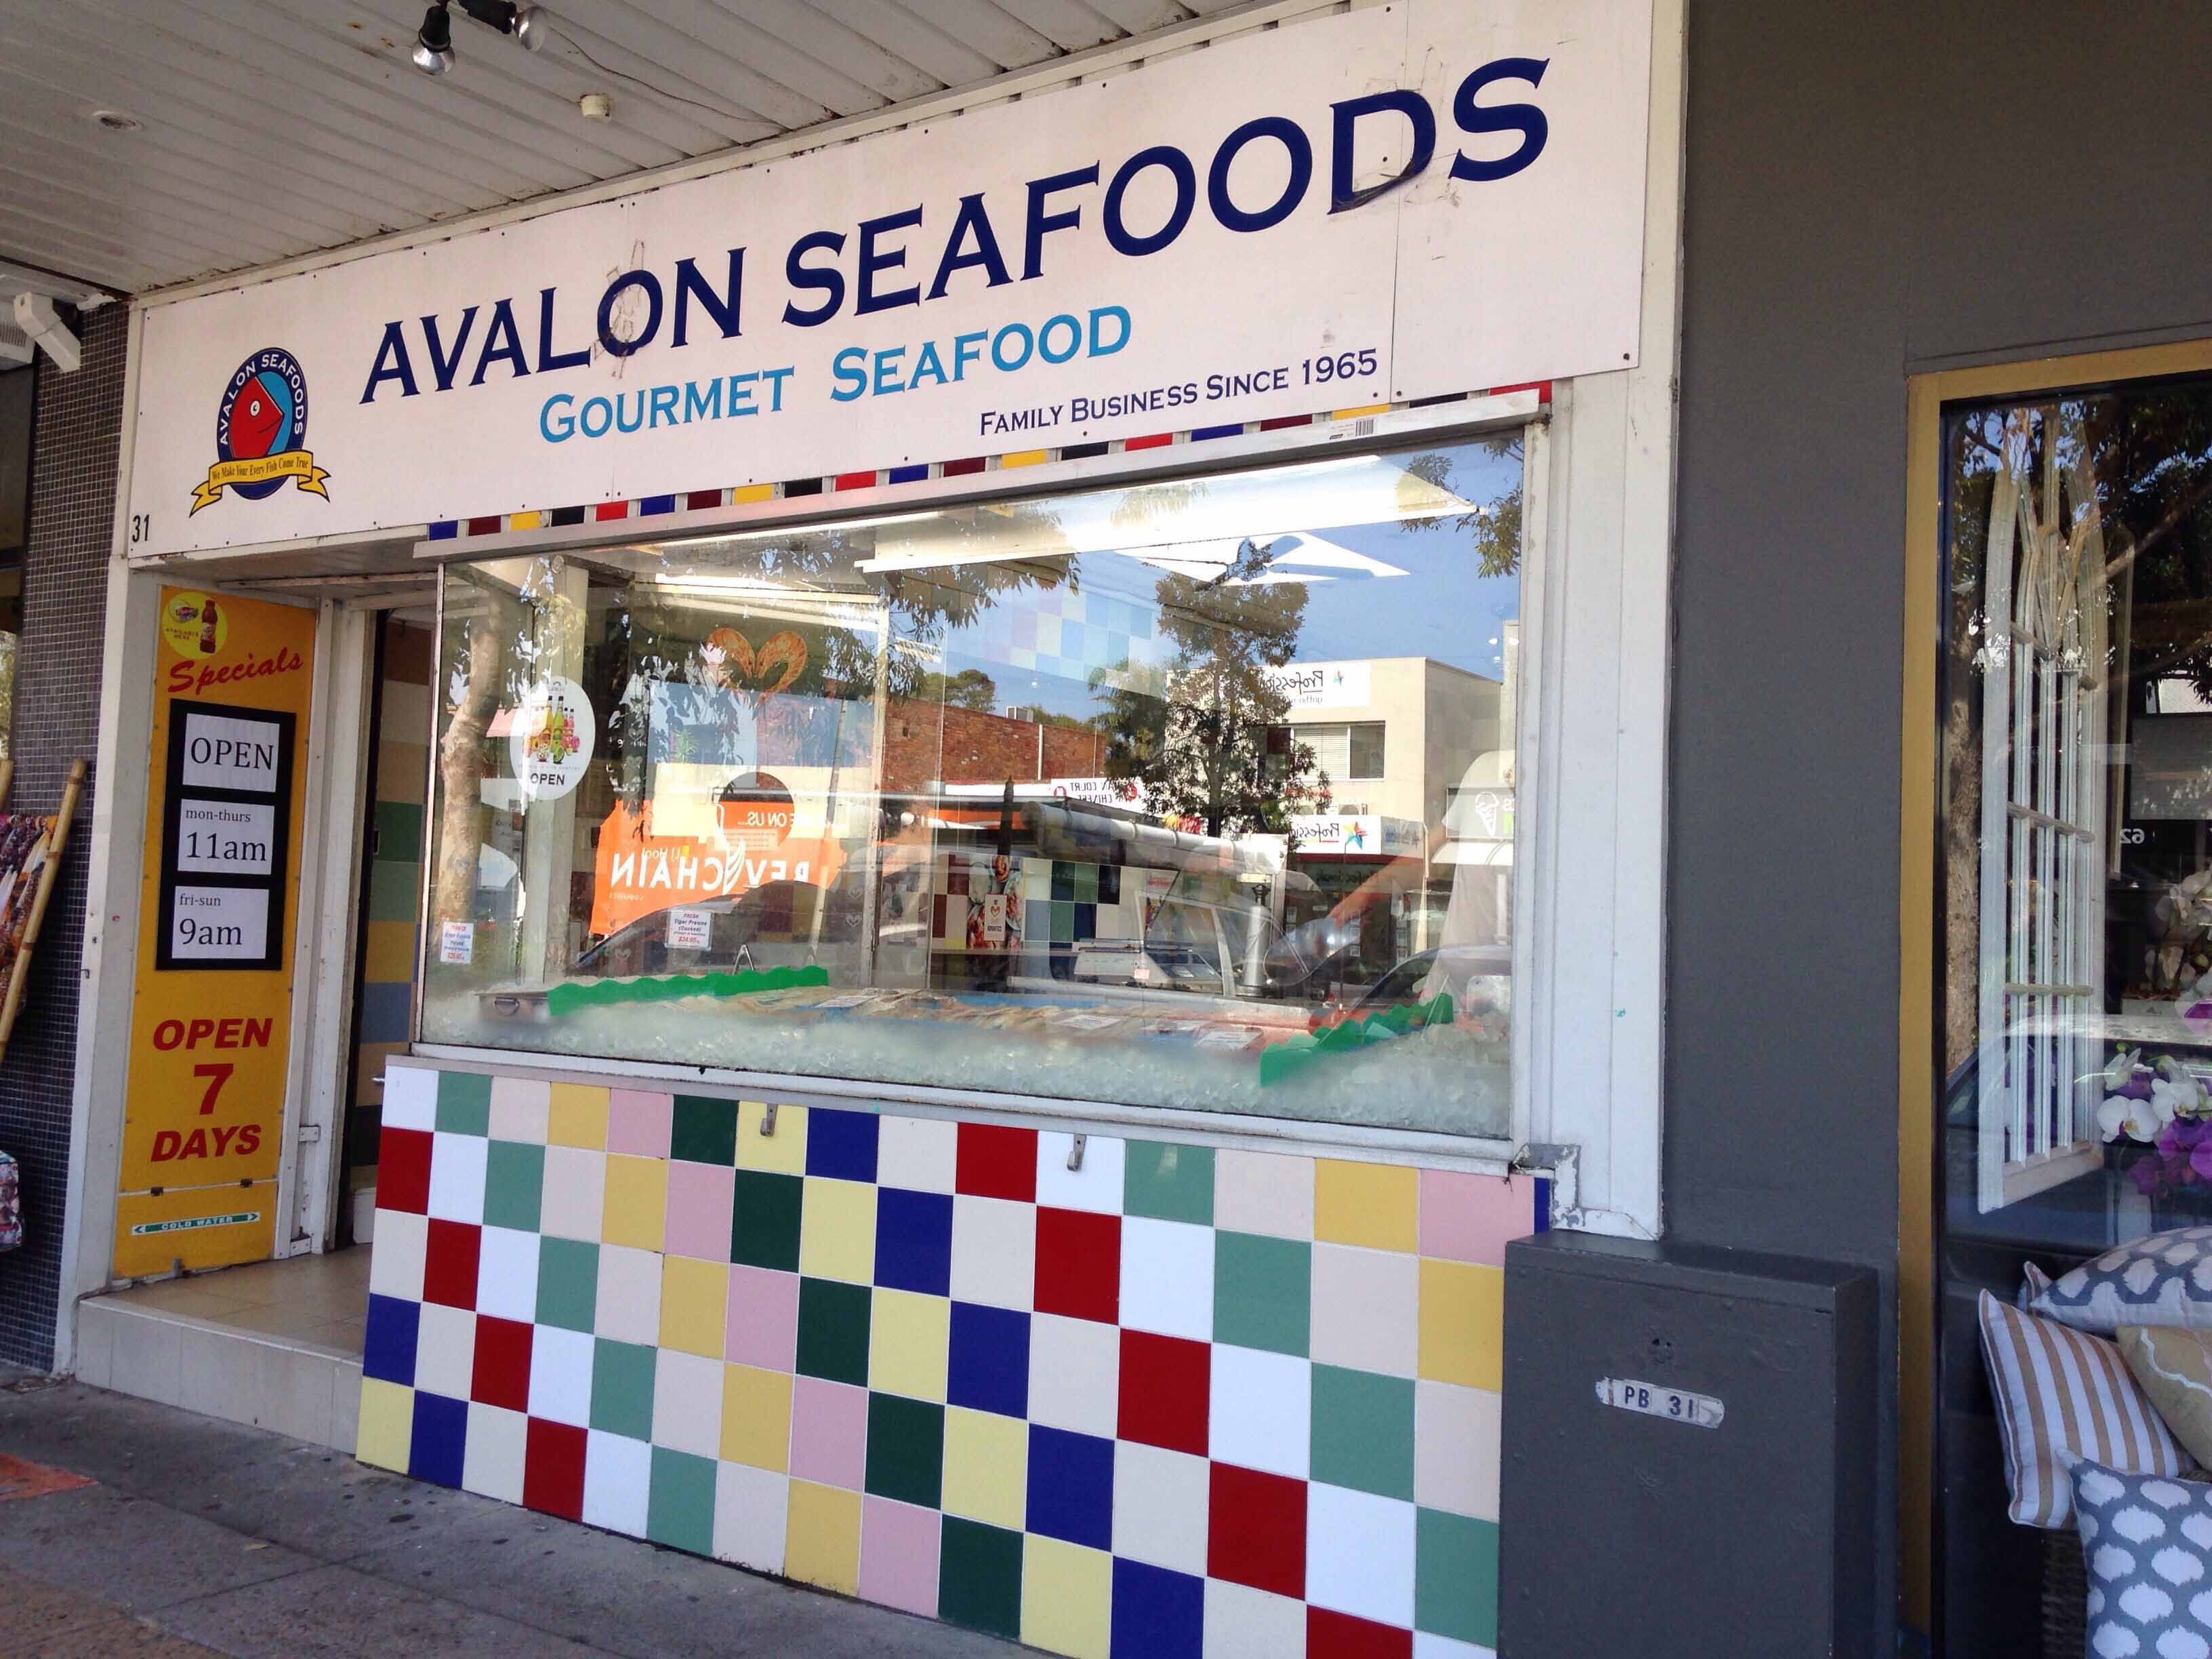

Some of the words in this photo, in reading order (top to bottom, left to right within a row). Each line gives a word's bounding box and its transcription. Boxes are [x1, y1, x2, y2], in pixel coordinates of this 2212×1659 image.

[359, 246, 747, 404] AVALON
[781, 58, 1551, 327] SEAFOODS
[540, 365, 794, 443] GOURMET
[830, 305, 1131, 402] SEAFOOD
[220, 361, 257, 445] AVALON
[261, 353, 304, 434] SEAFOODS
[980, 405, 1064, 436] FAMILY
[1071, 383, 1198, 423] BUSINESS
[1206, 367, 1289, 402] SINCE
[1302, 348, 1378, 385] 1965
[222, 466, 234, 477] Make
[249, 464, 264, 477] Every
[266, 461, 277, 473] Fish
[279, 457, 294, 468] Come
[296, 456, 308, 468] True
[132, 514, 150, 543] 31
[167, 647, 304, 695] Specials
[190, 737, 274, 771] OPEN
[530, 773, 565, 785] OPEN
[185, 808, 251, 823] mon-thurs
[186, 832, 268, 861] 11am
[180, 893, 222, 907] fri-sun
[180, 918, 243, 946] 9am
[152, 1018, 272, 1050] OPEN
[193, 1063, 234, 1115] 7
[150, 1124, 261, 1162] DAYS
[161, 1221, 192, 1231] COLD
[197, 1216, 232, 1226] WATER
[1624, 1385, 1650, 1408] PB
[1669, 1395, 1694, 1418] 31
